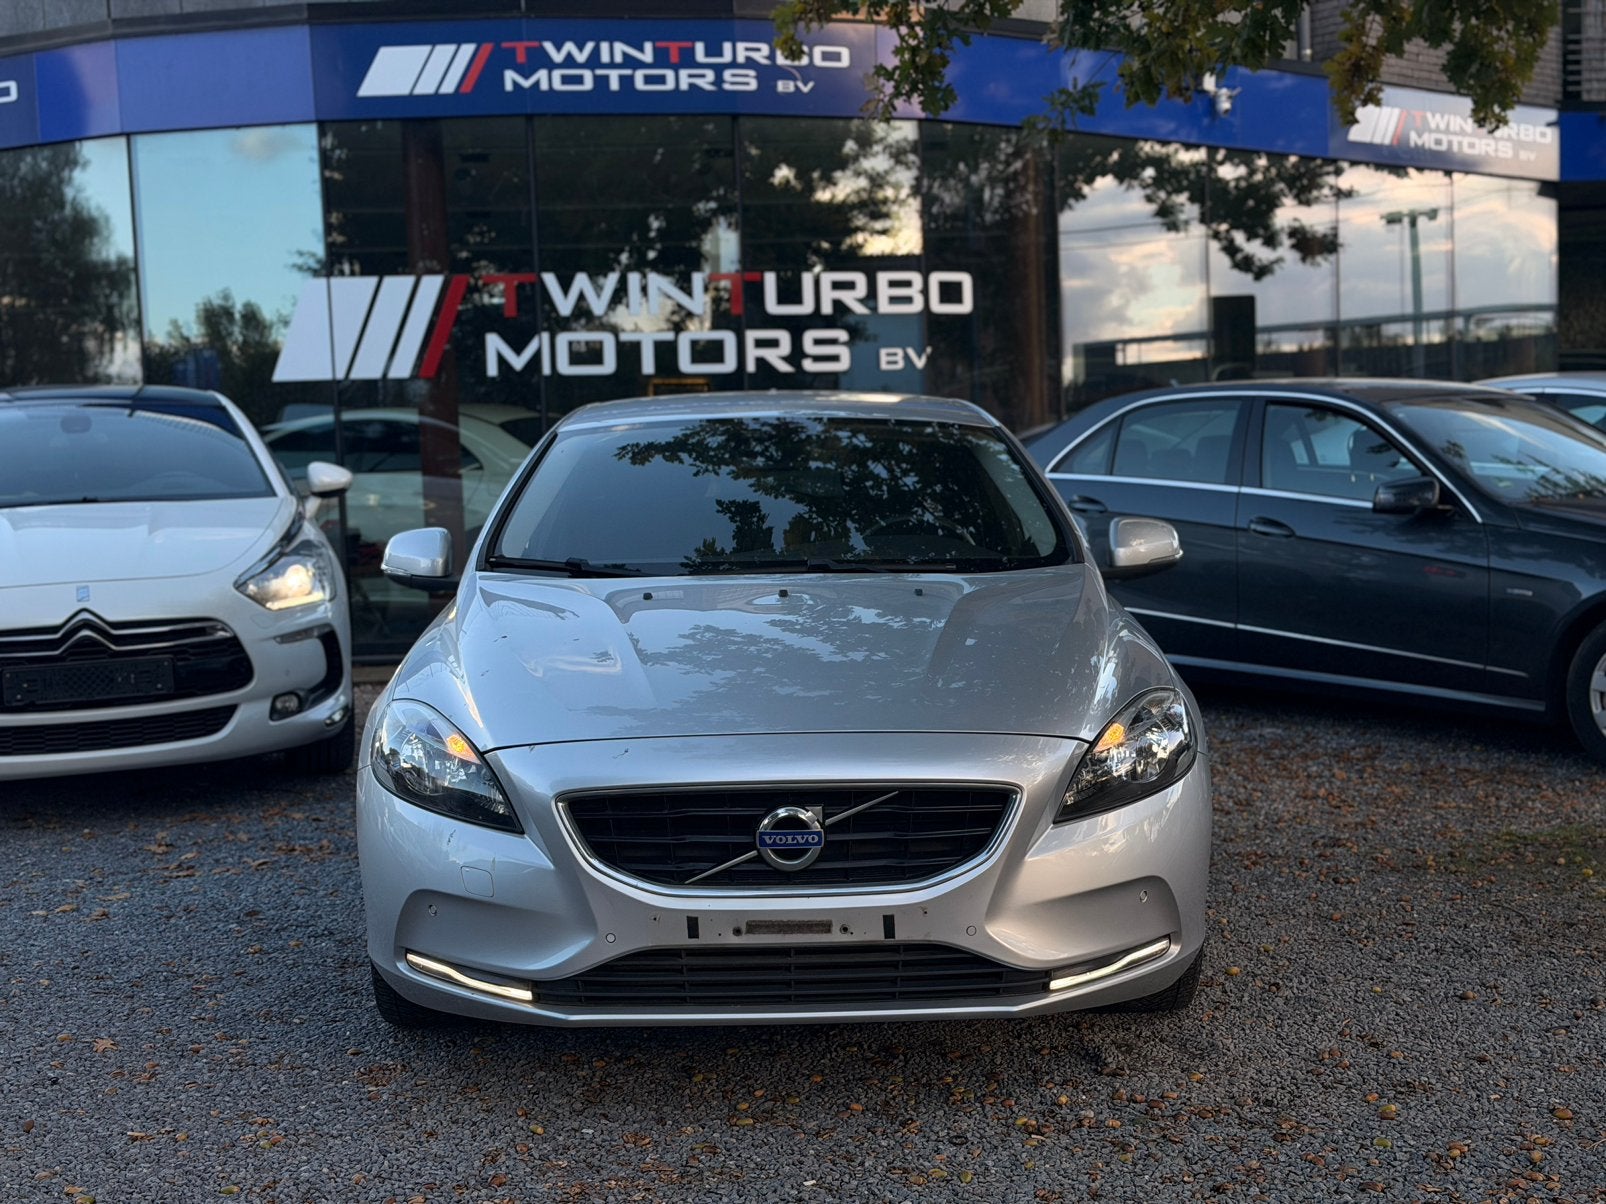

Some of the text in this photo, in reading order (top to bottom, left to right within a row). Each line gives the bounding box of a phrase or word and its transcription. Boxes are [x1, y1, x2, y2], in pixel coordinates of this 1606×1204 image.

[503, 68, 815, 93] MOTORS BV
[1409, 131, 1514, 159] MOTORS
[483, 271, 974, 318] TWINTURBO
[485, 328, 932, 377] MOTORS BV
[762, 834, 819, 845] VOLVO
